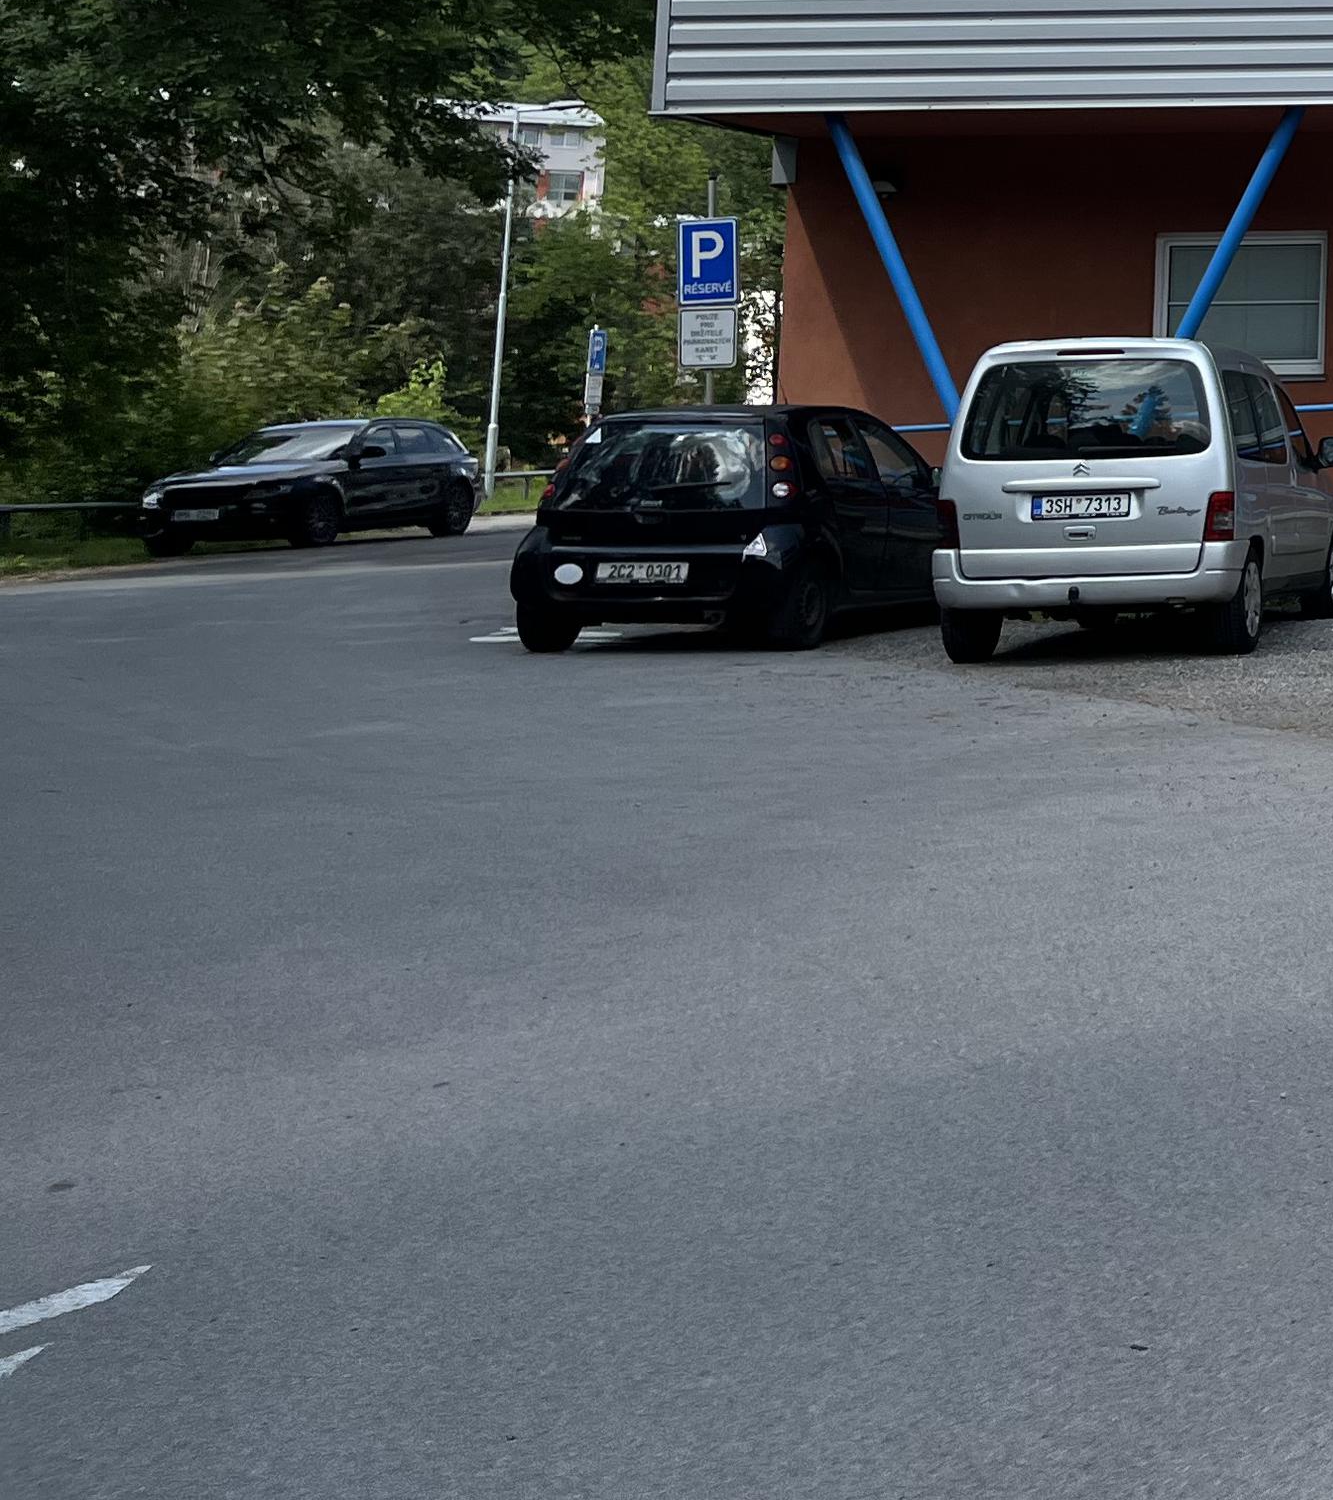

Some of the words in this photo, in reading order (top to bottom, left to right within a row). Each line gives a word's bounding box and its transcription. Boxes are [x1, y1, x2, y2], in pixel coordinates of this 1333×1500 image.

[691, 230, 724, 278] P
[684, 280, 732, 295] RÉSERVÉ
[1045, 498, 1072, 513] 3SH
[1084, 497, 1121, 512] 7313
